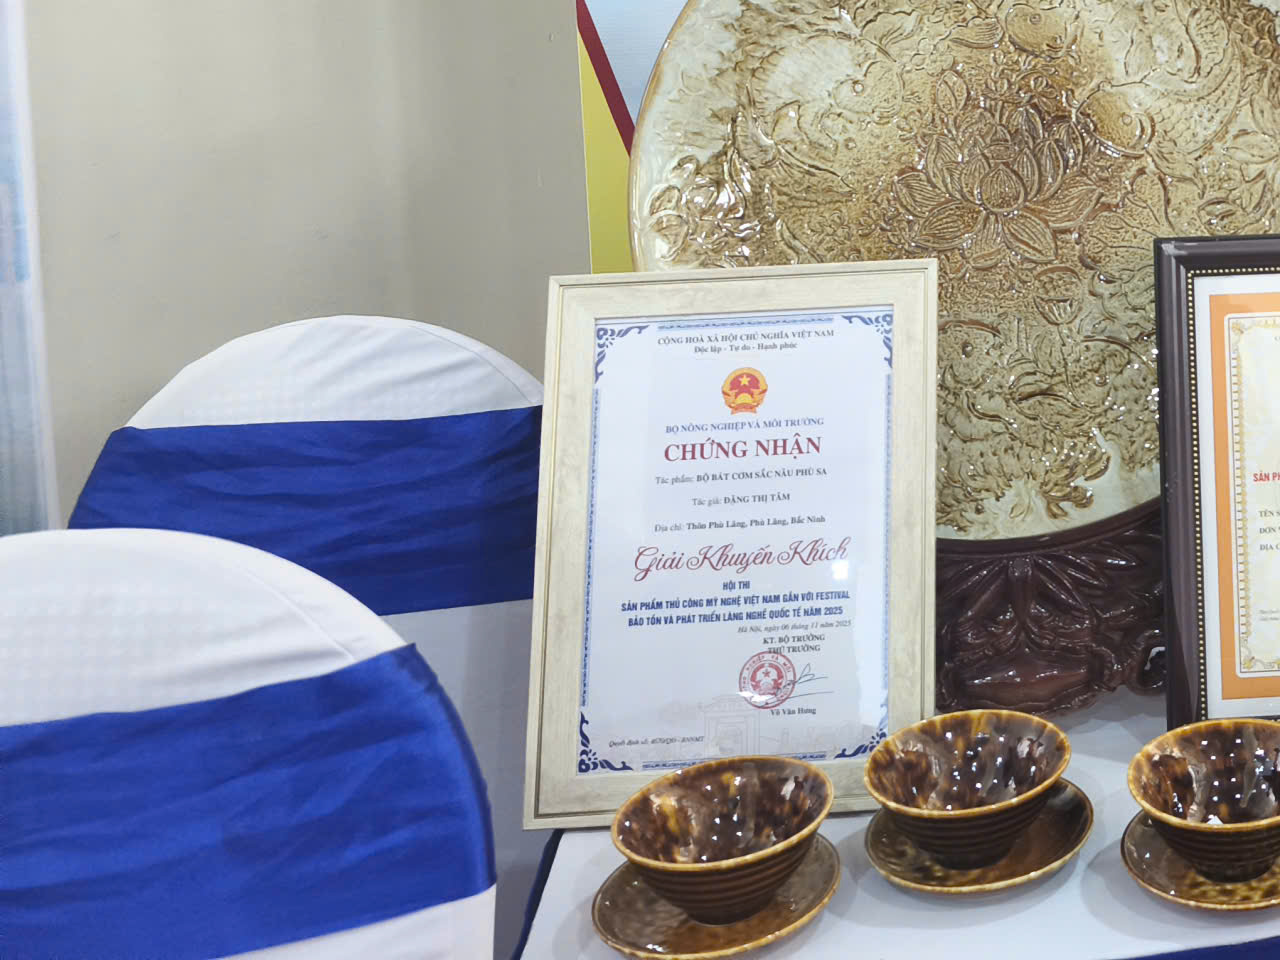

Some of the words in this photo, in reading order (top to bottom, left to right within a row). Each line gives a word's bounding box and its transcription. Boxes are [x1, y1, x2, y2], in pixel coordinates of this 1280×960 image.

[664, 436, 748, 462] CHỨNG
[755, 433, 821, 461] NHẬN
[1253, 472, 1270, 482] SẢN
[634, 545, 685, 581] Giải
[686, 542, 776, 576] Khuyến
[777, 537, 851, 565] Khích
[723, 580, 736, 591] HỘI
[739, 580, 750, 590] THI
[621, 600, 638, 612] SẢN
[640, 598, 663, 610] PHẨM
[666, 599, 680, 609] THỦ
[682, 597, 704, 608] CÔNG
[706, 597, 718, 607] MỸ
[720, 595, 741, 608] NGHỆ
[744, 594, 760, 605] VIỆT
[762, 595, 781, 604] NAM
[783, 591, 799, 602] GẮN
[801, 592, 814, 601] VỚI
[816, 590, 850, 600] FESTIVAL
[628, 616, 644, 627] BẢO
[646, 616, 662, 626] TỒN
[664, 615, 673, 625] VÀ
[676, 614, 696, 624] PHÁT
[698, 612, 721, 623] TRIỂN
[723, 612, 743, 622] LÀNG
[746, 610, 767, 620] NGHỀ
[769, 608, 790, 619] QUỐC
[792, 607, 801, 618] TẾ
[803, 608, 822, 617] NĂM
[824, 607, 843, 616] 2025
